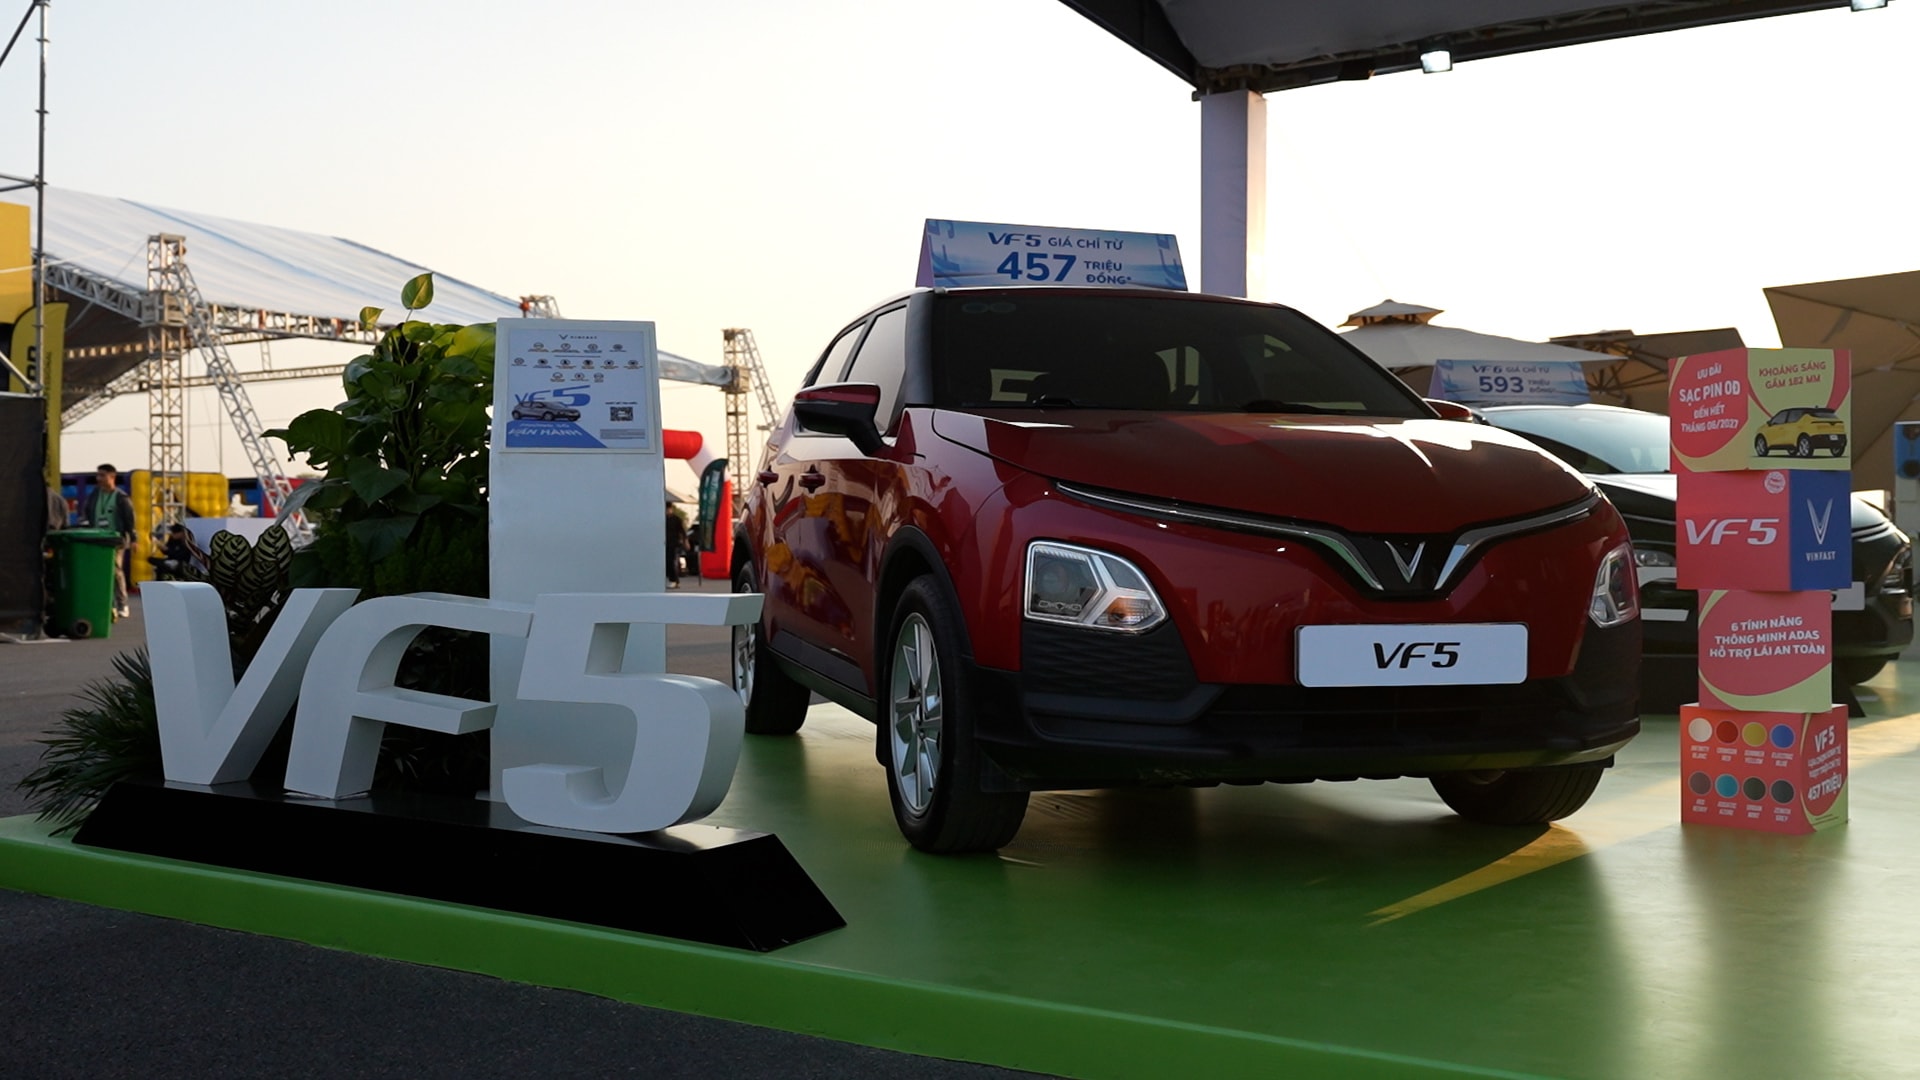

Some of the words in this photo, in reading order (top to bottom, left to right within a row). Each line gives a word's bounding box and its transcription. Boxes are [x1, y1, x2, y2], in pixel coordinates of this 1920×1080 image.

[1048, 235, 1073, 248] GIÁ
[996, 251, 1077, 282] 457
[1083, 260, 1122, 274] TRIỆU
[1479, 375, 1524, 393] 593
[1805, 374, 1821, 384] MM
[1679, 388, 1701, 406] SẠC
[1702, 382, 1722, 400] PIN
[1731, 622, 1739, 632] 6
[1741, 619, 1768, 630] TÍNH
[1715, 634, 1755, 645] THÔNG
[1757, 631, 1787, 643] MINH
[1788, 630, 1820, 640] ADAS
[1753, 644, 1772, 657] LÁI
[1773, 645, 1791, 655] AN
[1793, 642, 1825, 655] TOÀN
